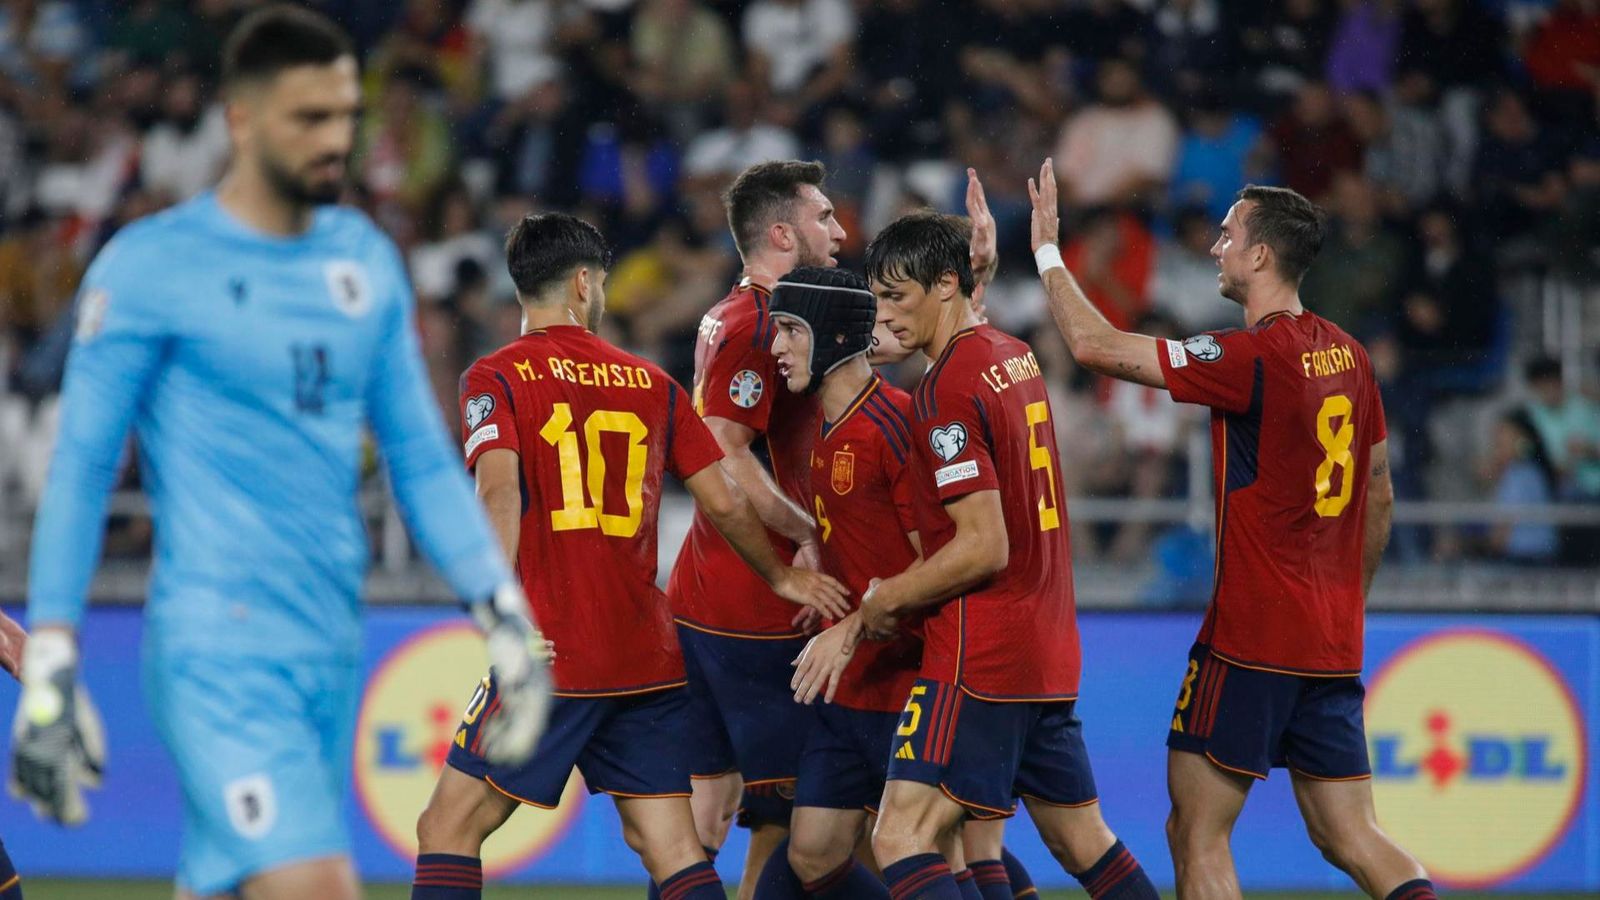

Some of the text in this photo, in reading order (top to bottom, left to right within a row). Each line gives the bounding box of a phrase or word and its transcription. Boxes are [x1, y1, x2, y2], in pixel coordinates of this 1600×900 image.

[513, 357, 652, 389] M. ASENSIO
[981, 364, 1010, 393] LE
[1301, 343, 1356, 378] FABIÁN
[539, 403, 648, 538] 10
[1025, 400, 1060, 532] 5
[1314, 395, 1354, 518] 8
[896, 685, 927, 736] 5
